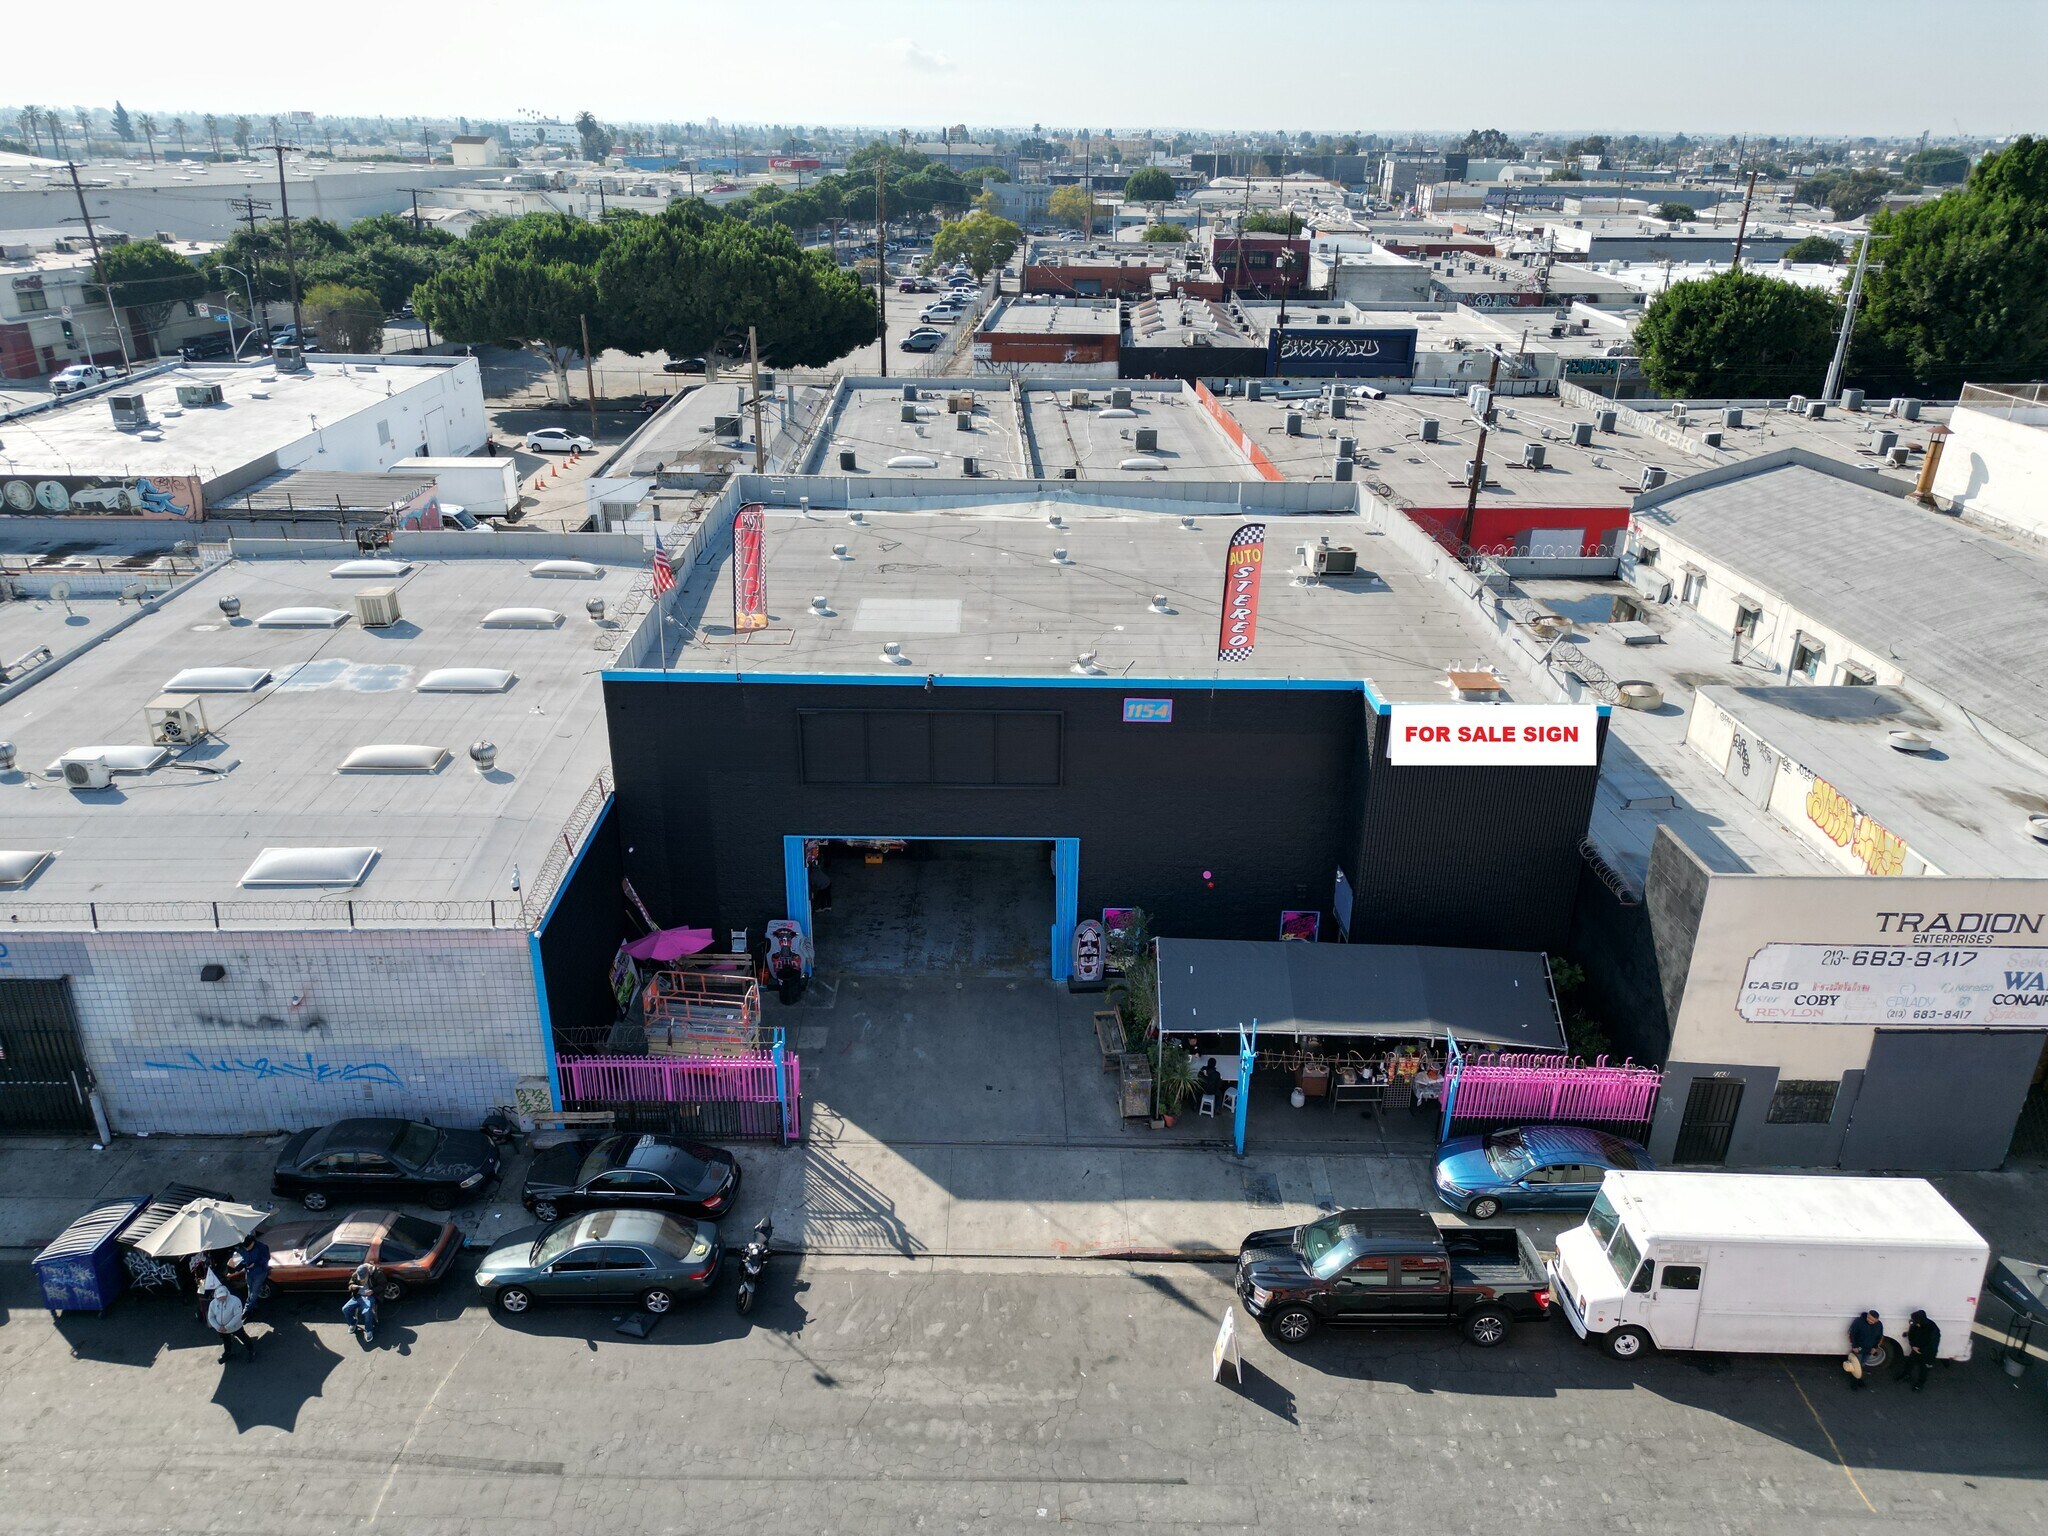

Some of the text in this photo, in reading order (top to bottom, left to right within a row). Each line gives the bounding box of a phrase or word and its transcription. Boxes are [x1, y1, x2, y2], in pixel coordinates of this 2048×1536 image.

[1229, 548, 1261, 565] AUTO
[1228, 566, 1255, 646] STEREO
[1127, 703, 1169, 718] 1154
[1876, 912, 2046, 934] TRADION
[1912, 934, 1994, 944] ENTERPRISES
[1748, 981, 1799, 991] CASIO
[2004, 971, 2048, 991] WA
[1794, 994, 1841, 1006] COBY
[1886, 996, 1937, 1008] EPILADY
[1755, 1008, 1825, 1017] REVLON
[1886, 1009, 1972, 1019] (213) 683-8417
